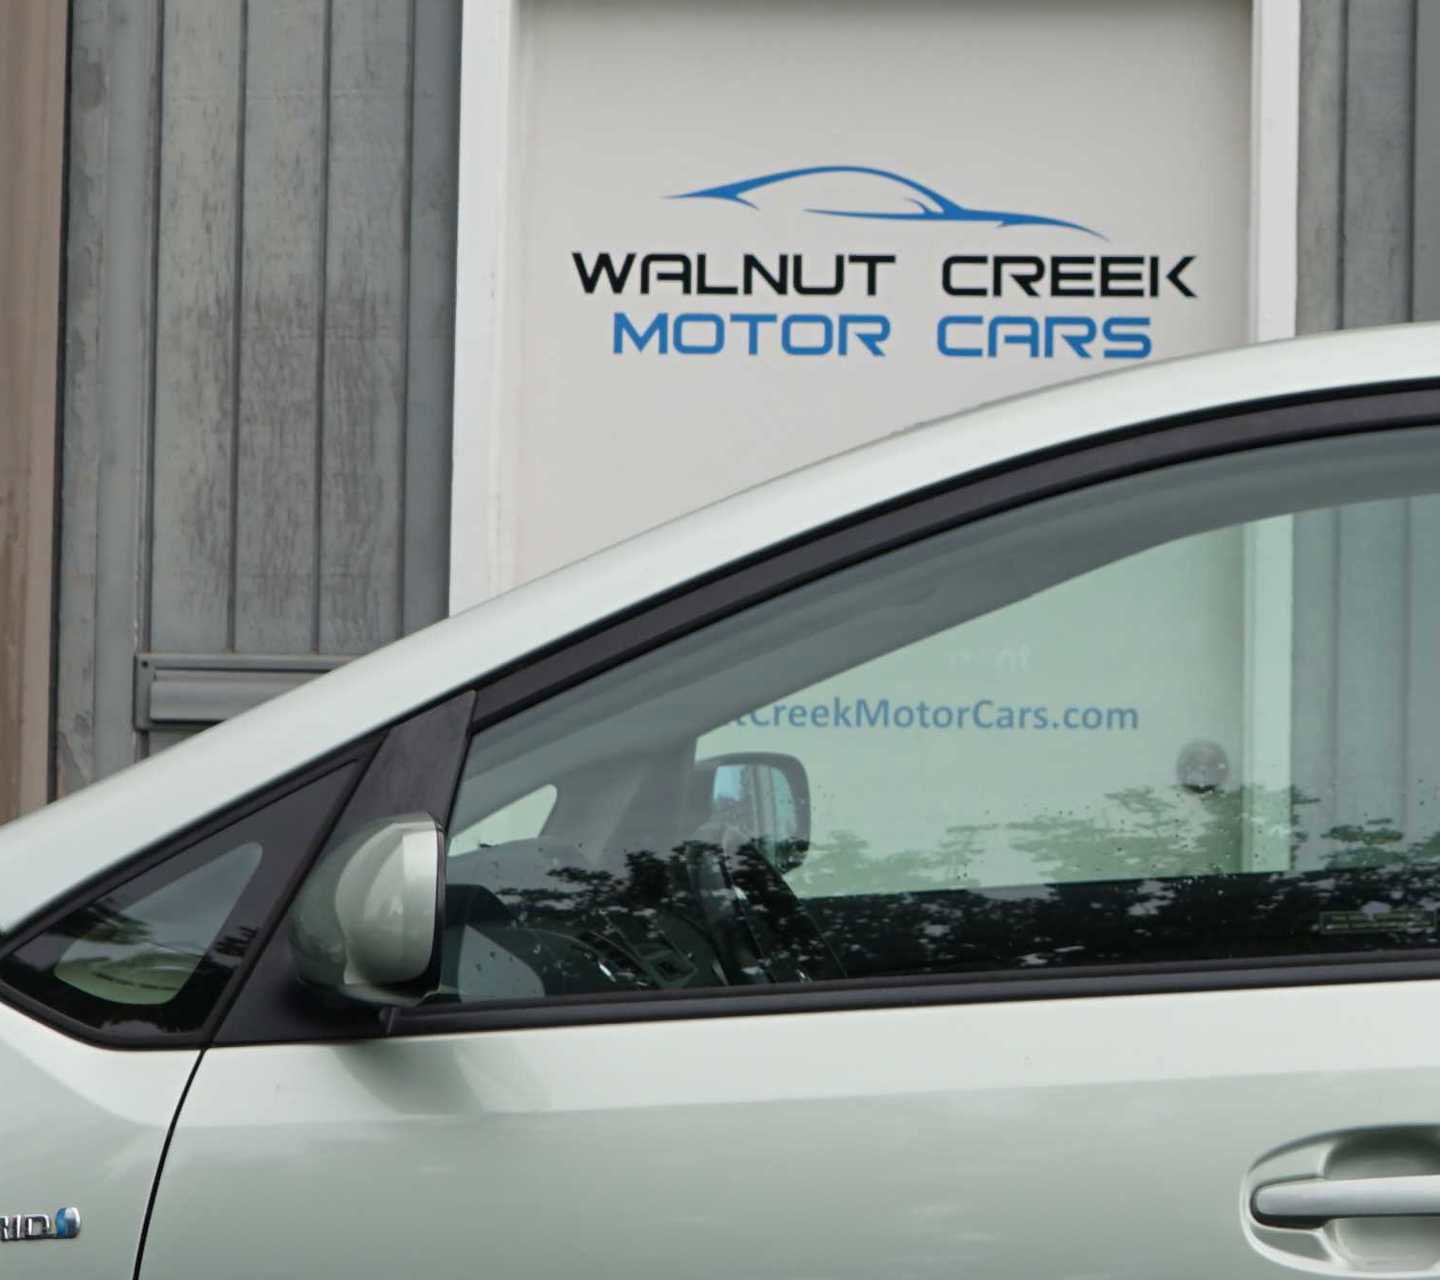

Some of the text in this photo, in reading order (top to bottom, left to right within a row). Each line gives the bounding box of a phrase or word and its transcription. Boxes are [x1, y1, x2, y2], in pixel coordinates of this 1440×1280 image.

[572, 251, 1198, 299] WALNUT CREEK
[613, 312, 1154, 360] MOTOR CARS
